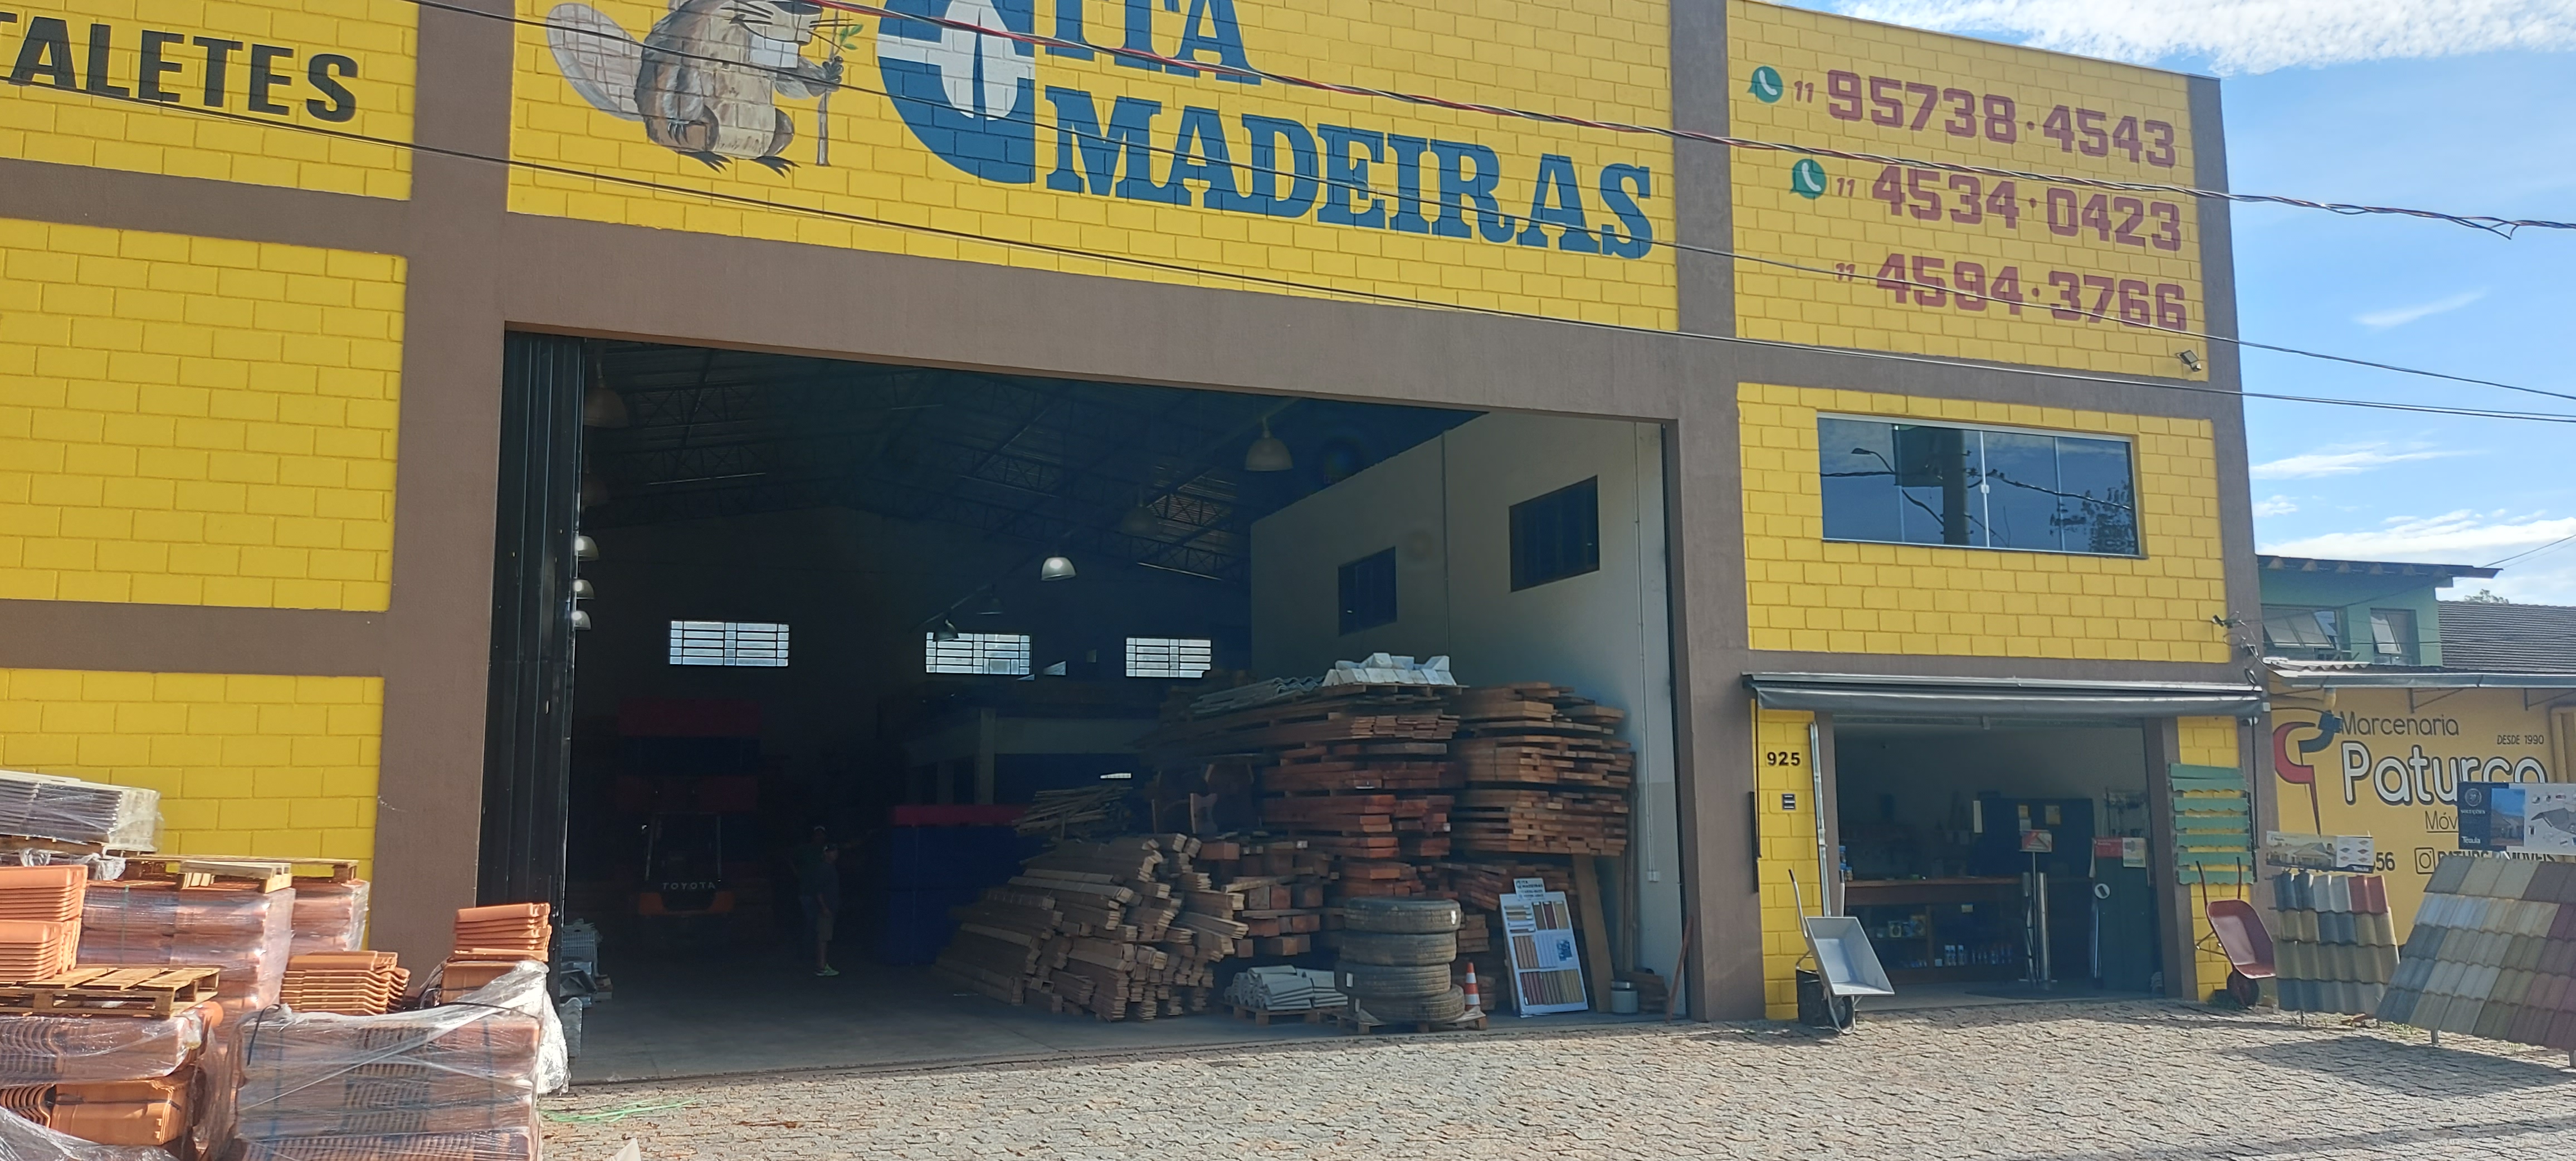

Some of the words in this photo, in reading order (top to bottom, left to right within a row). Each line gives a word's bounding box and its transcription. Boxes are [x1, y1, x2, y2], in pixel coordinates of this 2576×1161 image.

[1793, 80, 1814, 104] 11
[1045, 85, 1653, 260] MADEIRAS
[1837, 177, 1855, 197] 11
[1835, 262, 1855, 282] 11
[2341, 711, 2460, 736] Marcenaria
[2496, 734, 2521, 745] DESDE
[2524, 734, 2545, 745] 1990
[1767, 751, 1801, 767] 925
[2374, 851, 2396, 872] 56
[662, 881, 716, 890] TOYOTA
